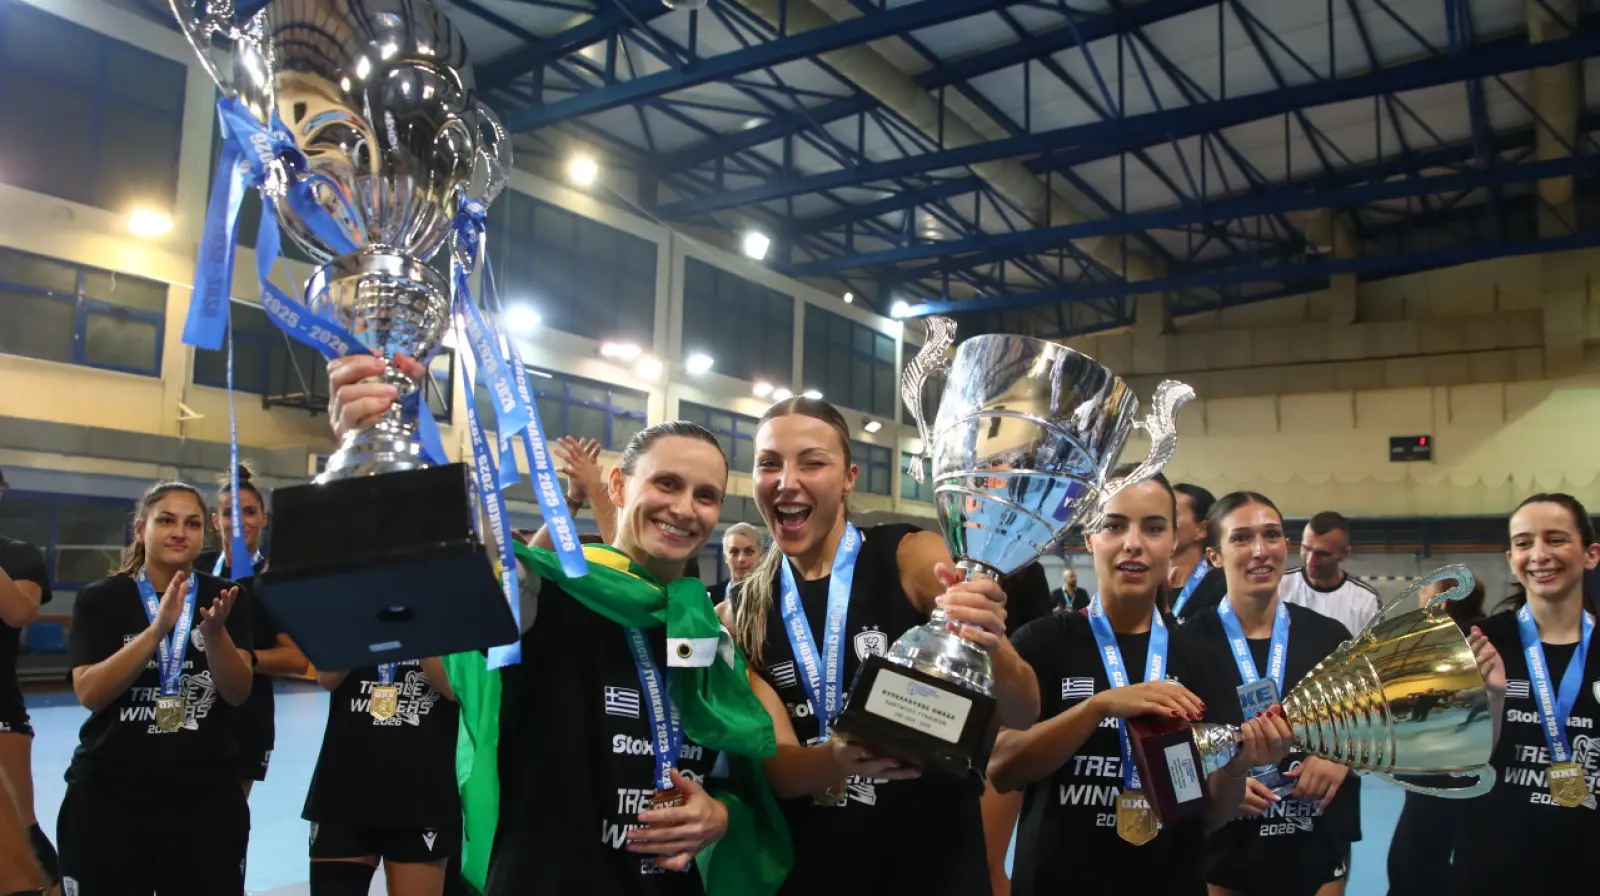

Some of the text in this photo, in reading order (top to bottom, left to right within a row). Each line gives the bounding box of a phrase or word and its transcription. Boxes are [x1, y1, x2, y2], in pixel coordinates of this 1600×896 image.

[263, 291, 300, 329] 2025
[478, 454, 494, 492] 2025
[537, 472, 560, 508] 2025
[552, 515, 576, 553] 2026
[791, 617, 808, 642] 2025
[1112, 671, 1125, 687] 025
[350, 698, 434, 715] WIERS
[825, 684, 836, 712] 2025
[120, 706, 210, 722] WINRS
[1546, 716, 1559, 737] 2025
[656, 722, 670, 754] 2025
[662, 761, 674, 790] 2026
[1072, 755, 1124, 778] TRE
[617, 788, 654, 815] TRE
[1096, 813, 1117, 827] 20
[1260, 823, 1297, 836] 2026
